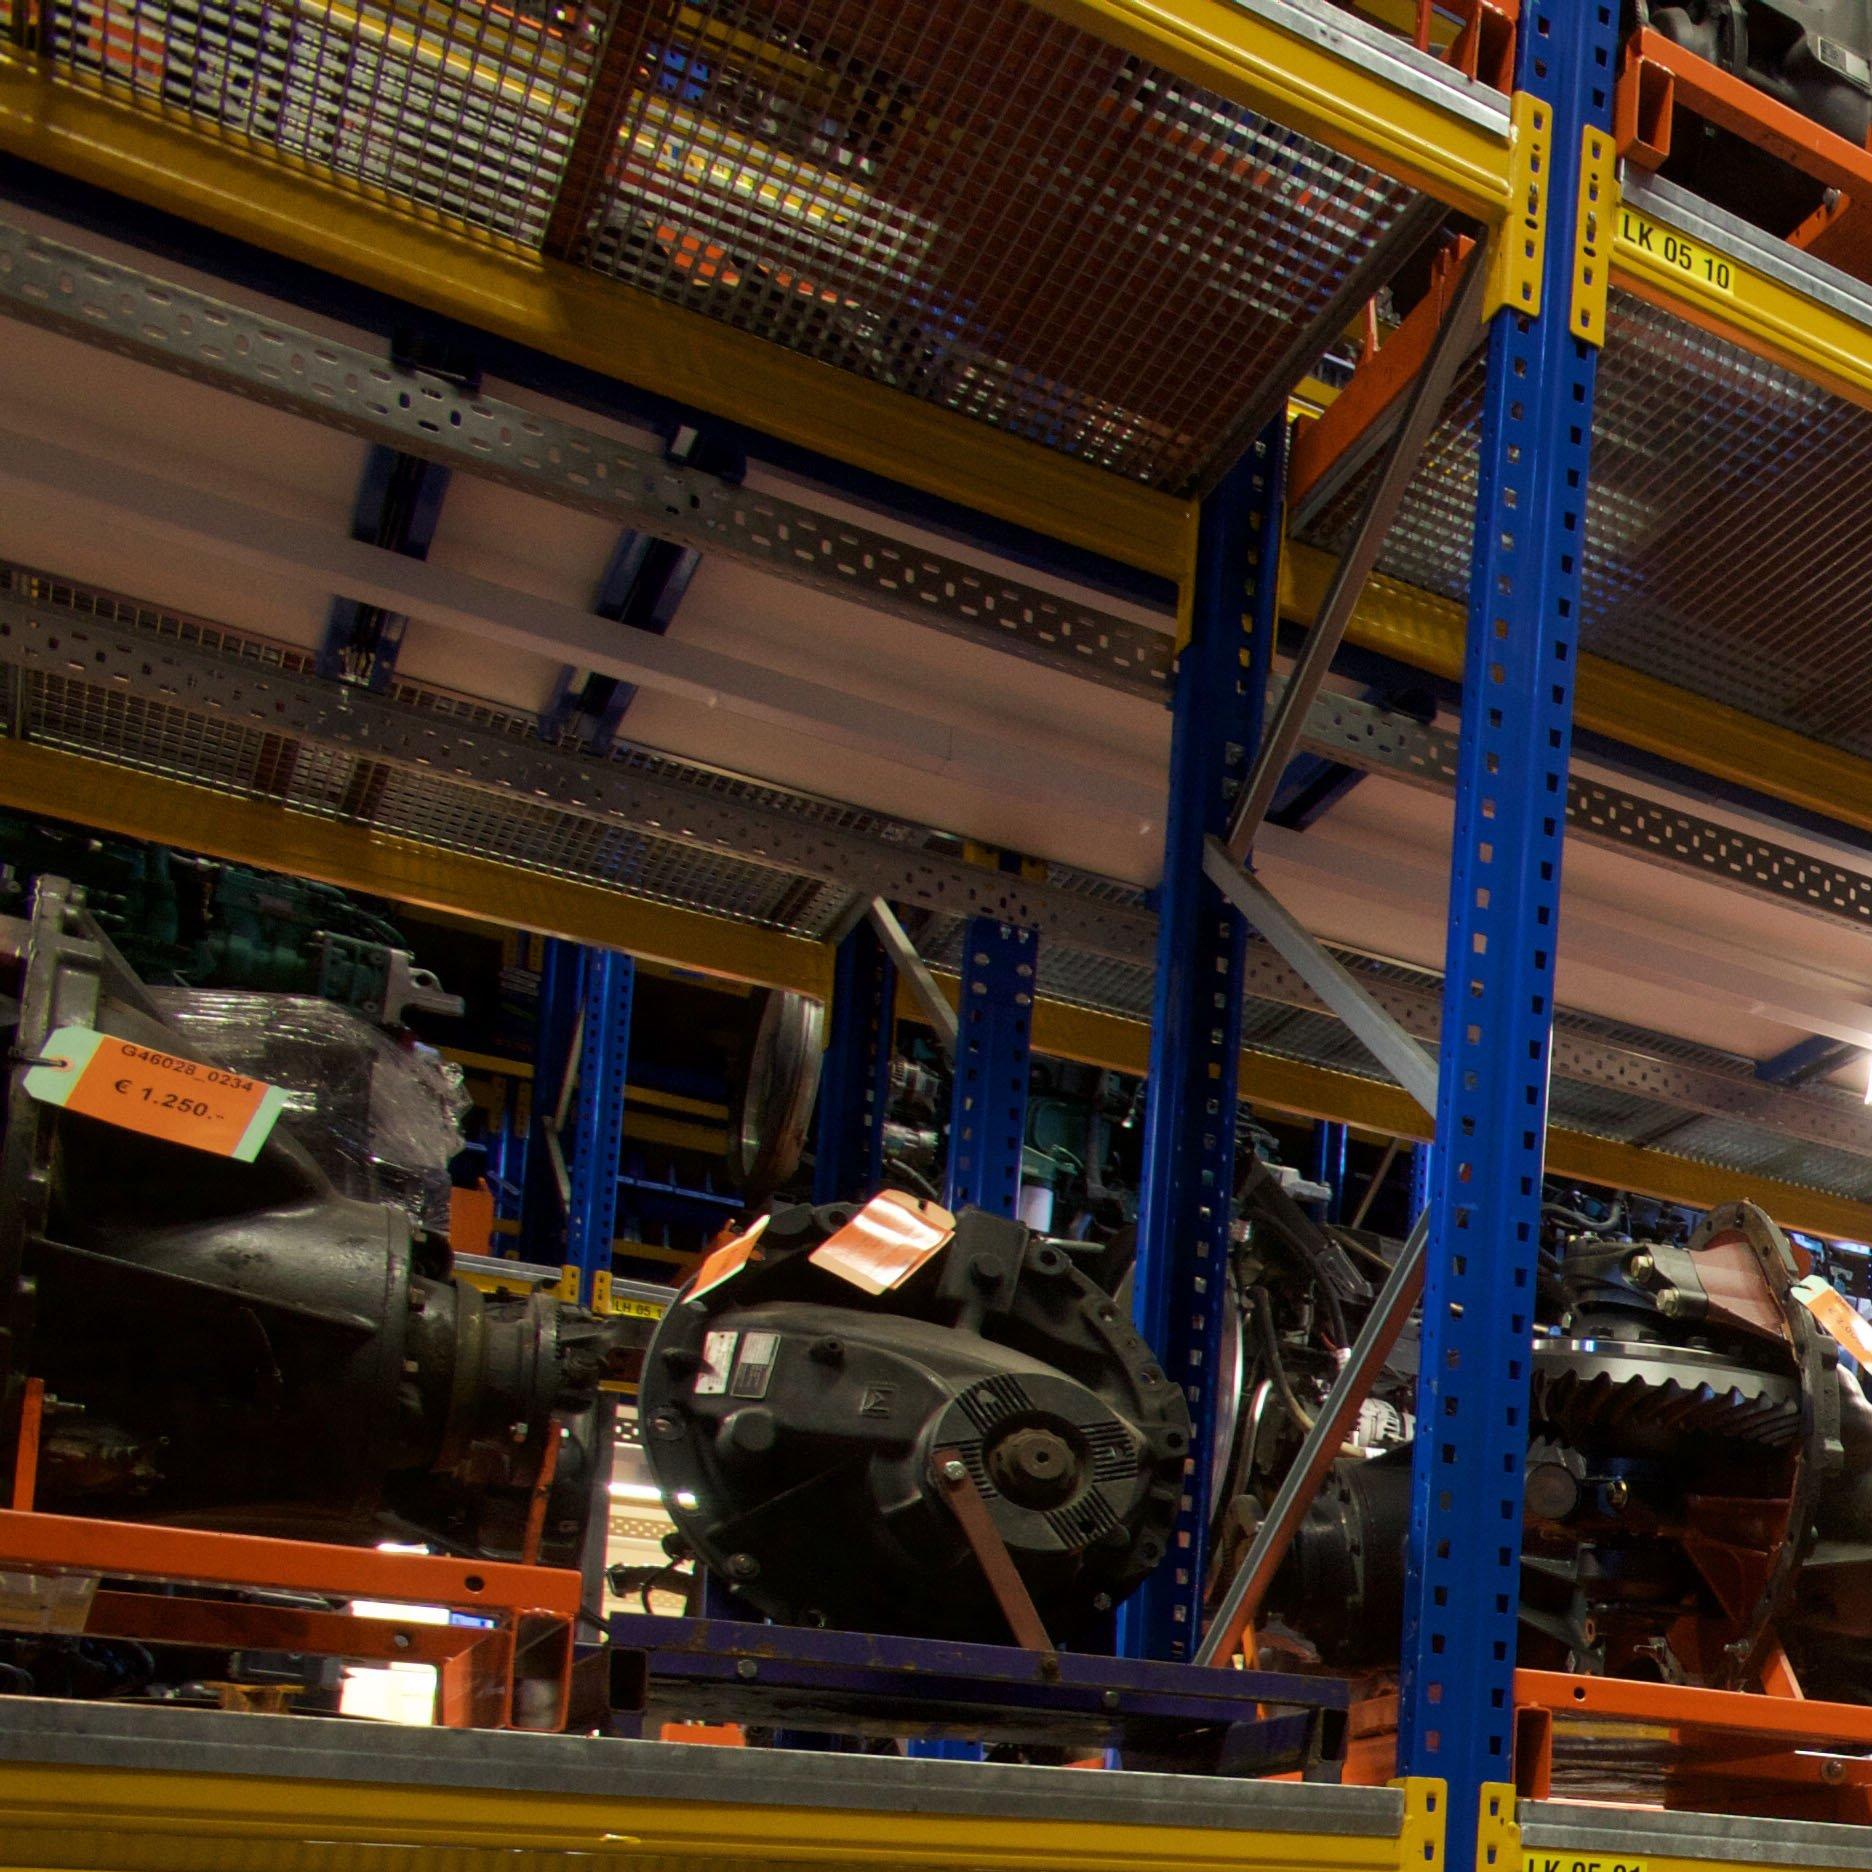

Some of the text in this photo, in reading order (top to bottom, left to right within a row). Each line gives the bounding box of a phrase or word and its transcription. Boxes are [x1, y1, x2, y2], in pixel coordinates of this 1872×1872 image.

[1623, 214, 1730, 290] LK 05 10
[120, 1043, 254, 1093] G46028_0234
[113, 1078, 133, 1095] €
[615, 1299, 632, 1313] LH
